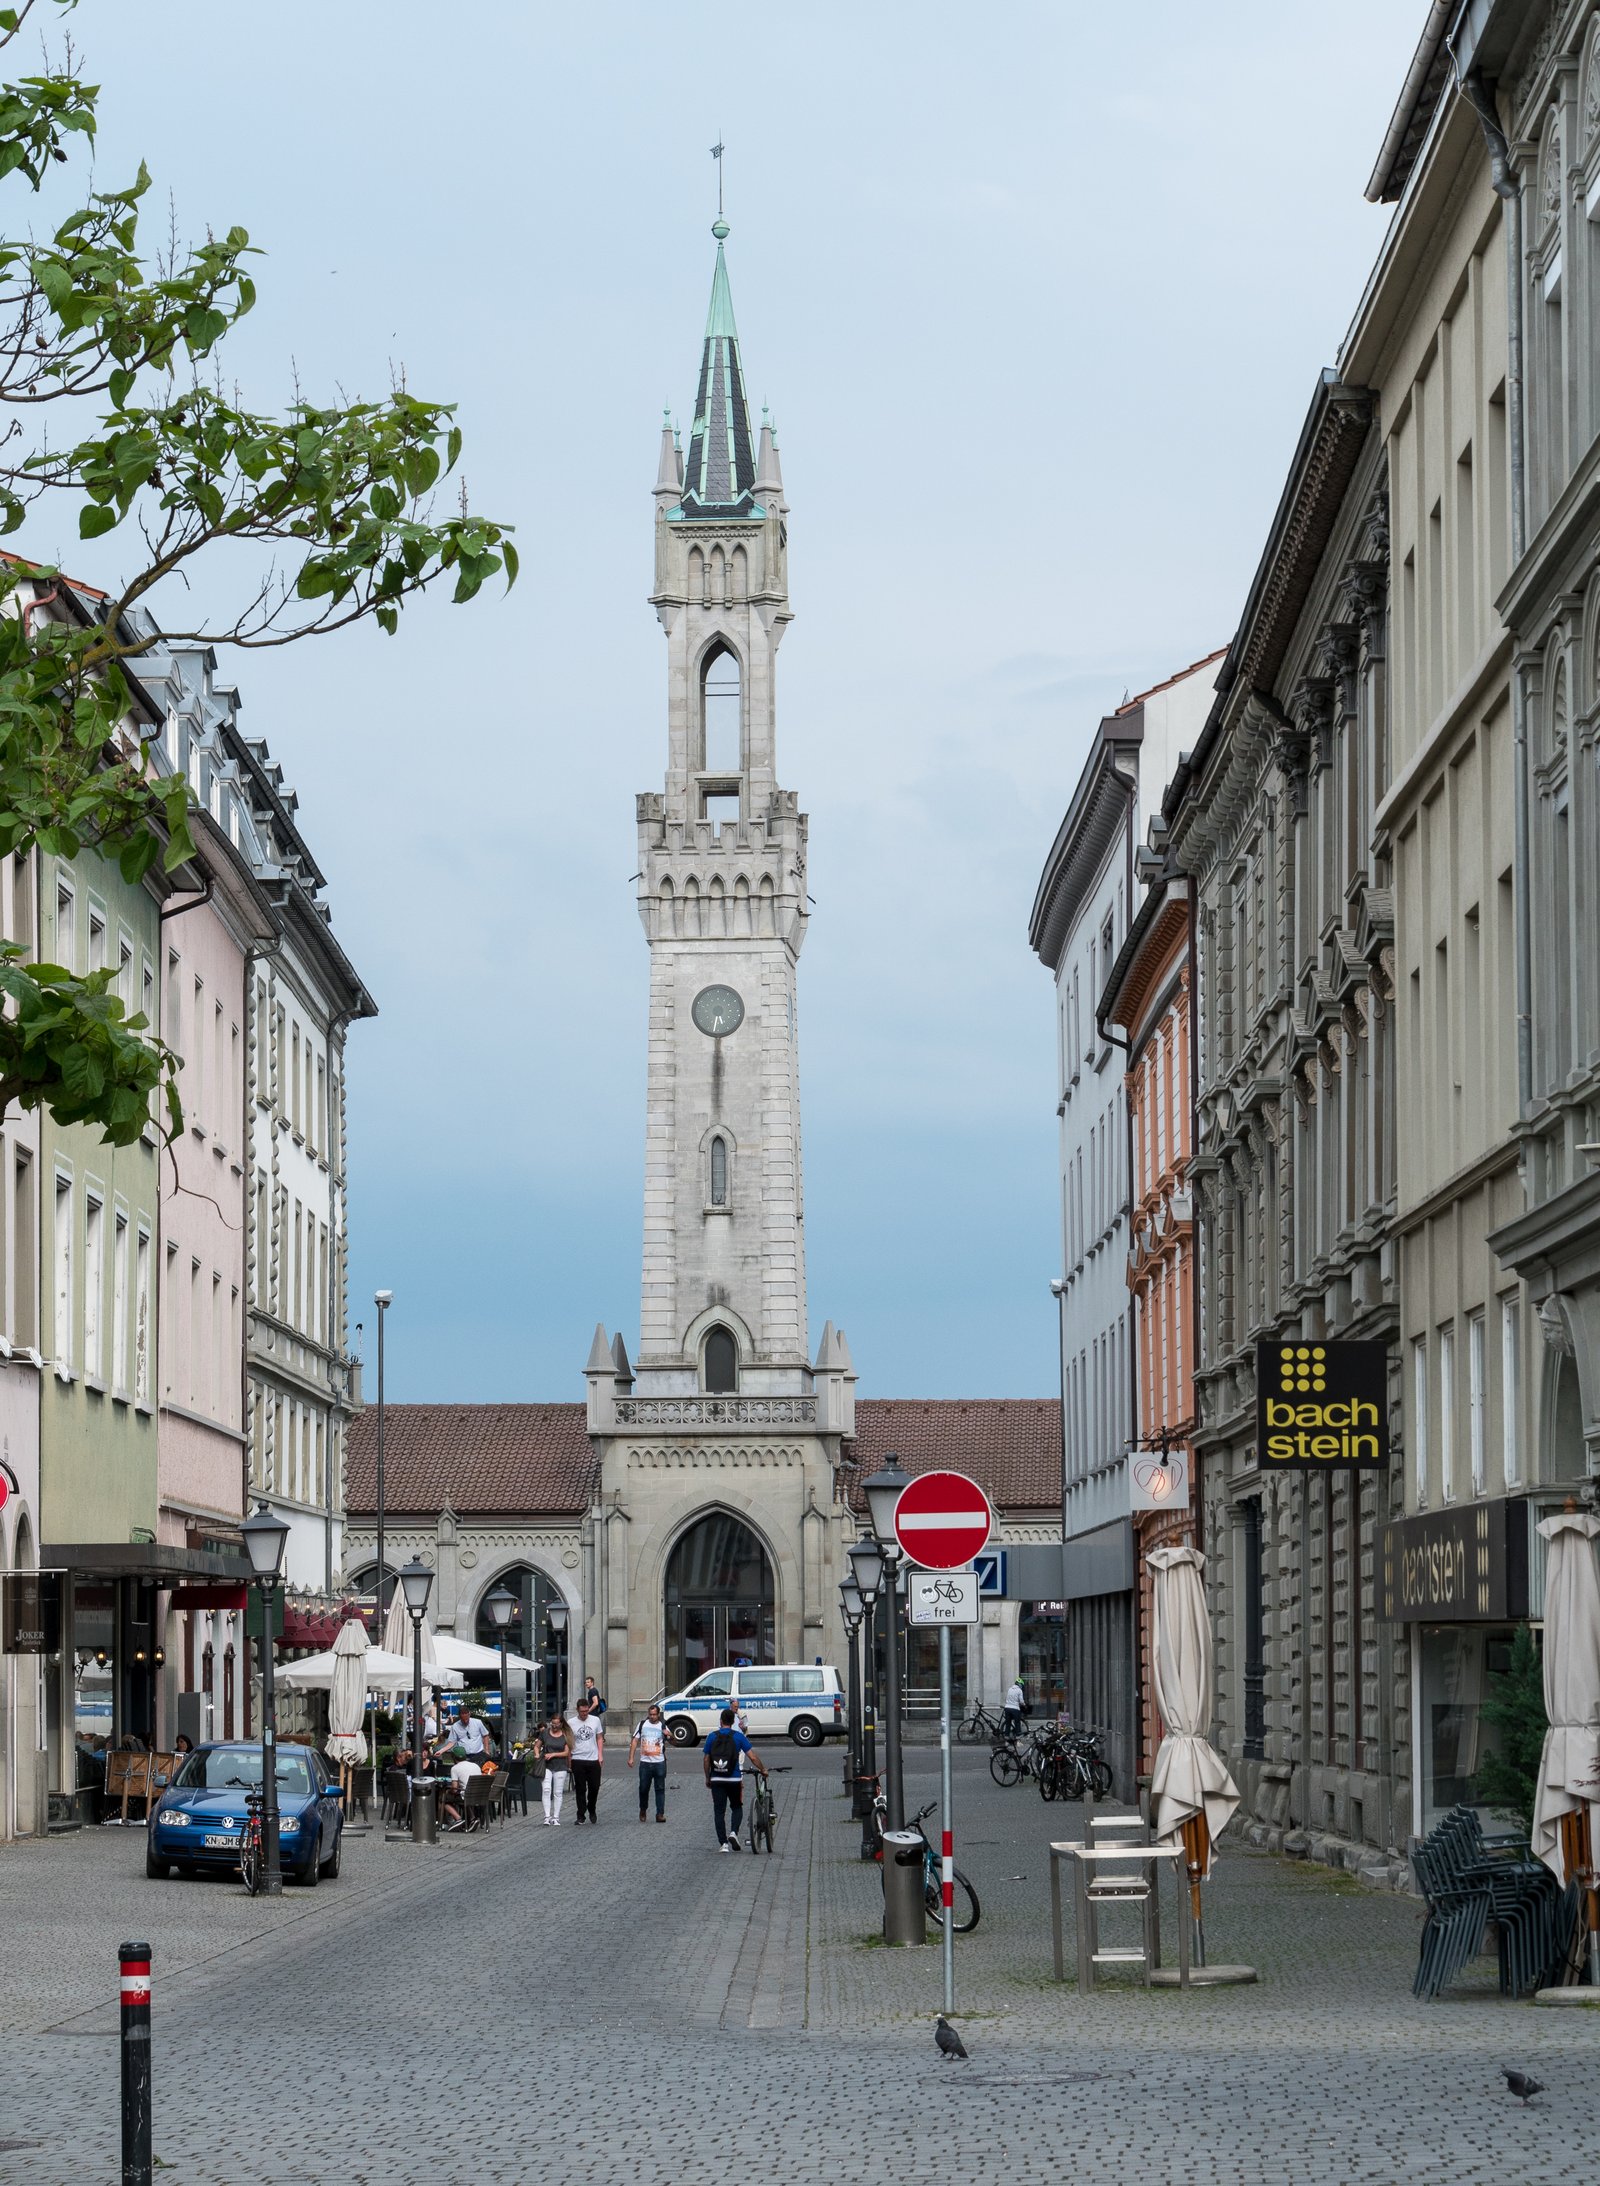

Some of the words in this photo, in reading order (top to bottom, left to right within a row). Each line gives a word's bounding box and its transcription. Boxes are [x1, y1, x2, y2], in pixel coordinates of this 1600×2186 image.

[1266, 1397, 1378, 1427] bach
[1266, 1428, 1379, 1459] stein
[1402, 1523, 1465, 1606] bachstein
[934, 1607, 955, 1617] frei
[746, 1701, 778, 1709] POLIZEI
[205, 1836, 217, 1844] KN
[221, 1837, 234, 1846] JM
